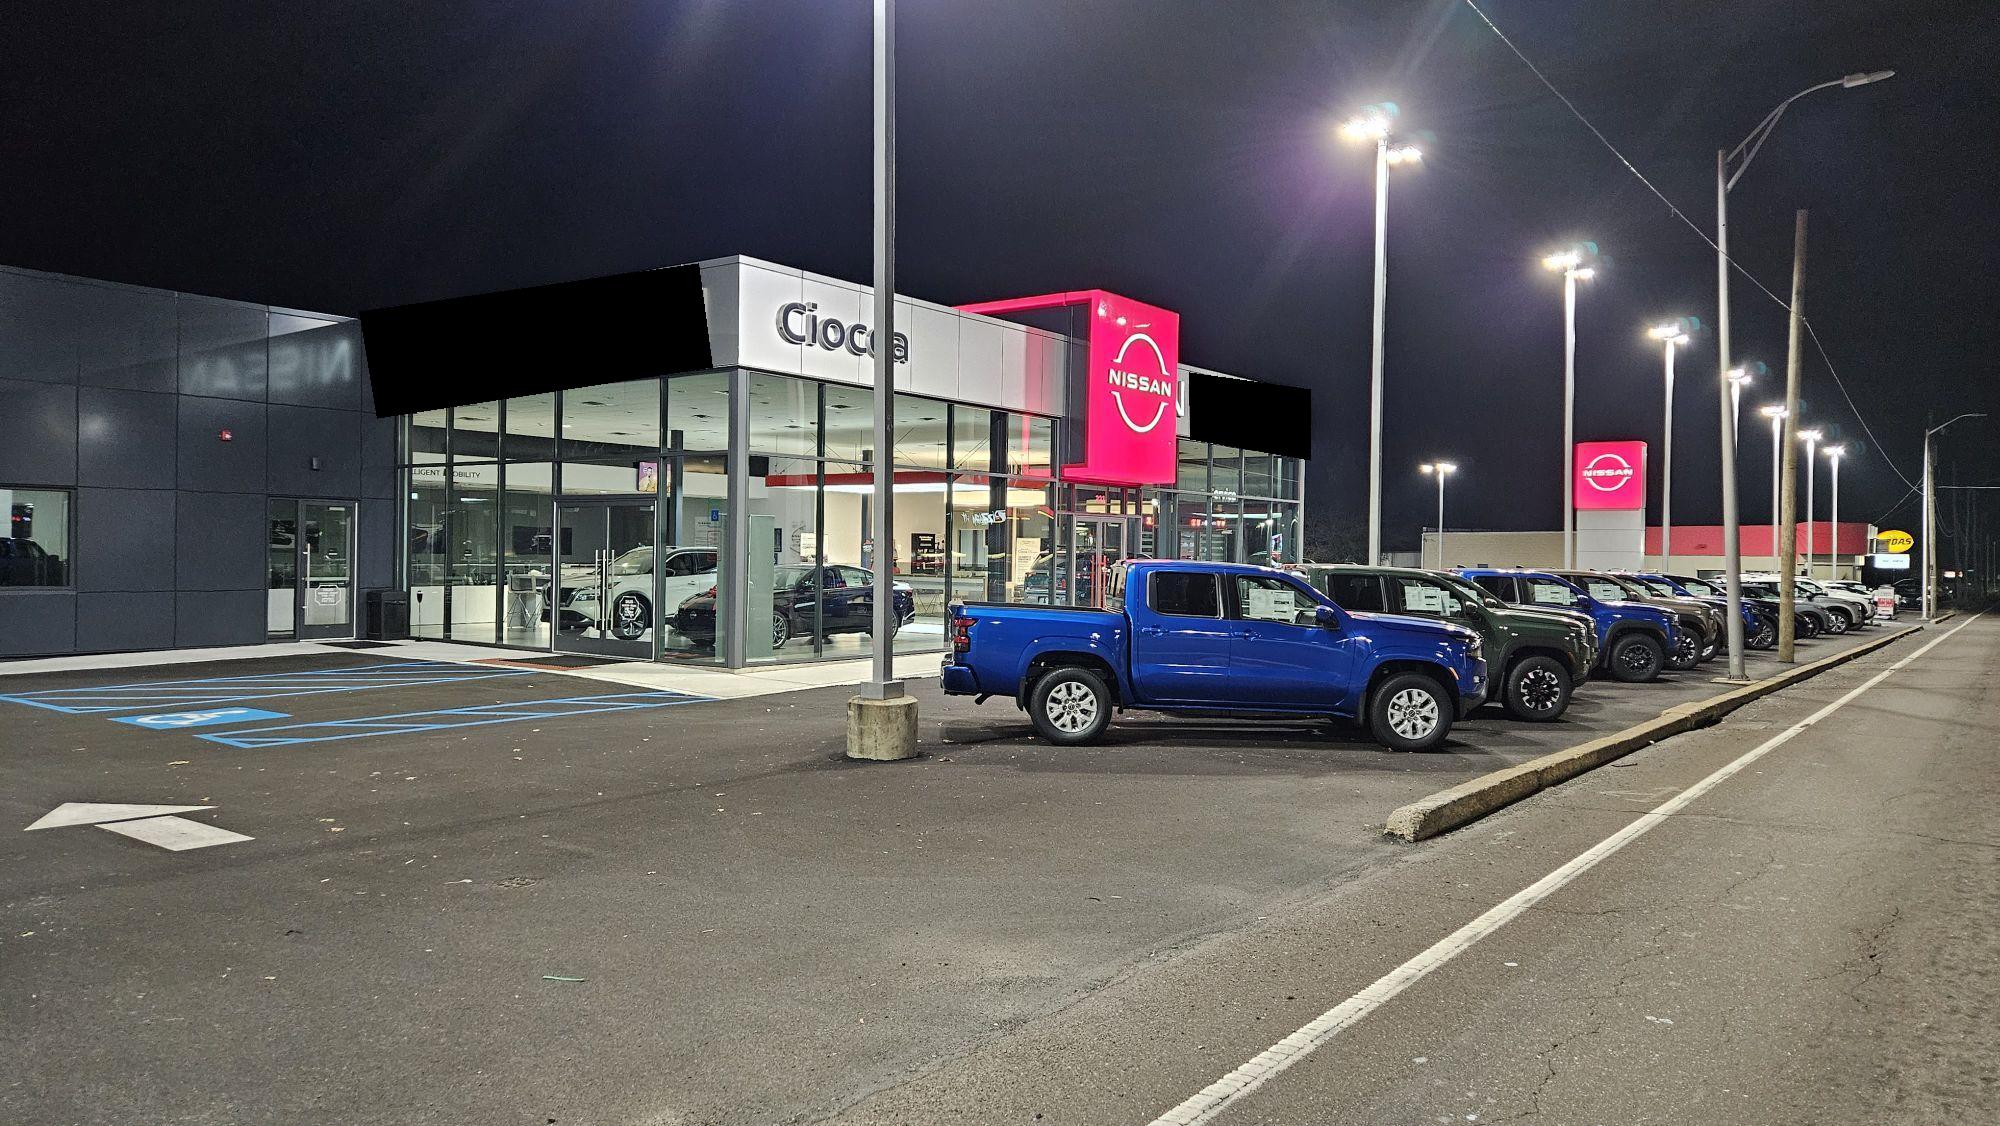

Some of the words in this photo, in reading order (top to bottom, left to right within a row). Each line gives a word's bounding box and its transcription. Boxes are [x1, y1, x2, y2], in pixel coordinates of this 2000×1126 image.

[1108, 368, 1172, 397] NISSAN
[412, 468, 440, 476] LIGENT
[1582, 468, 1634, 477] NISSAN
